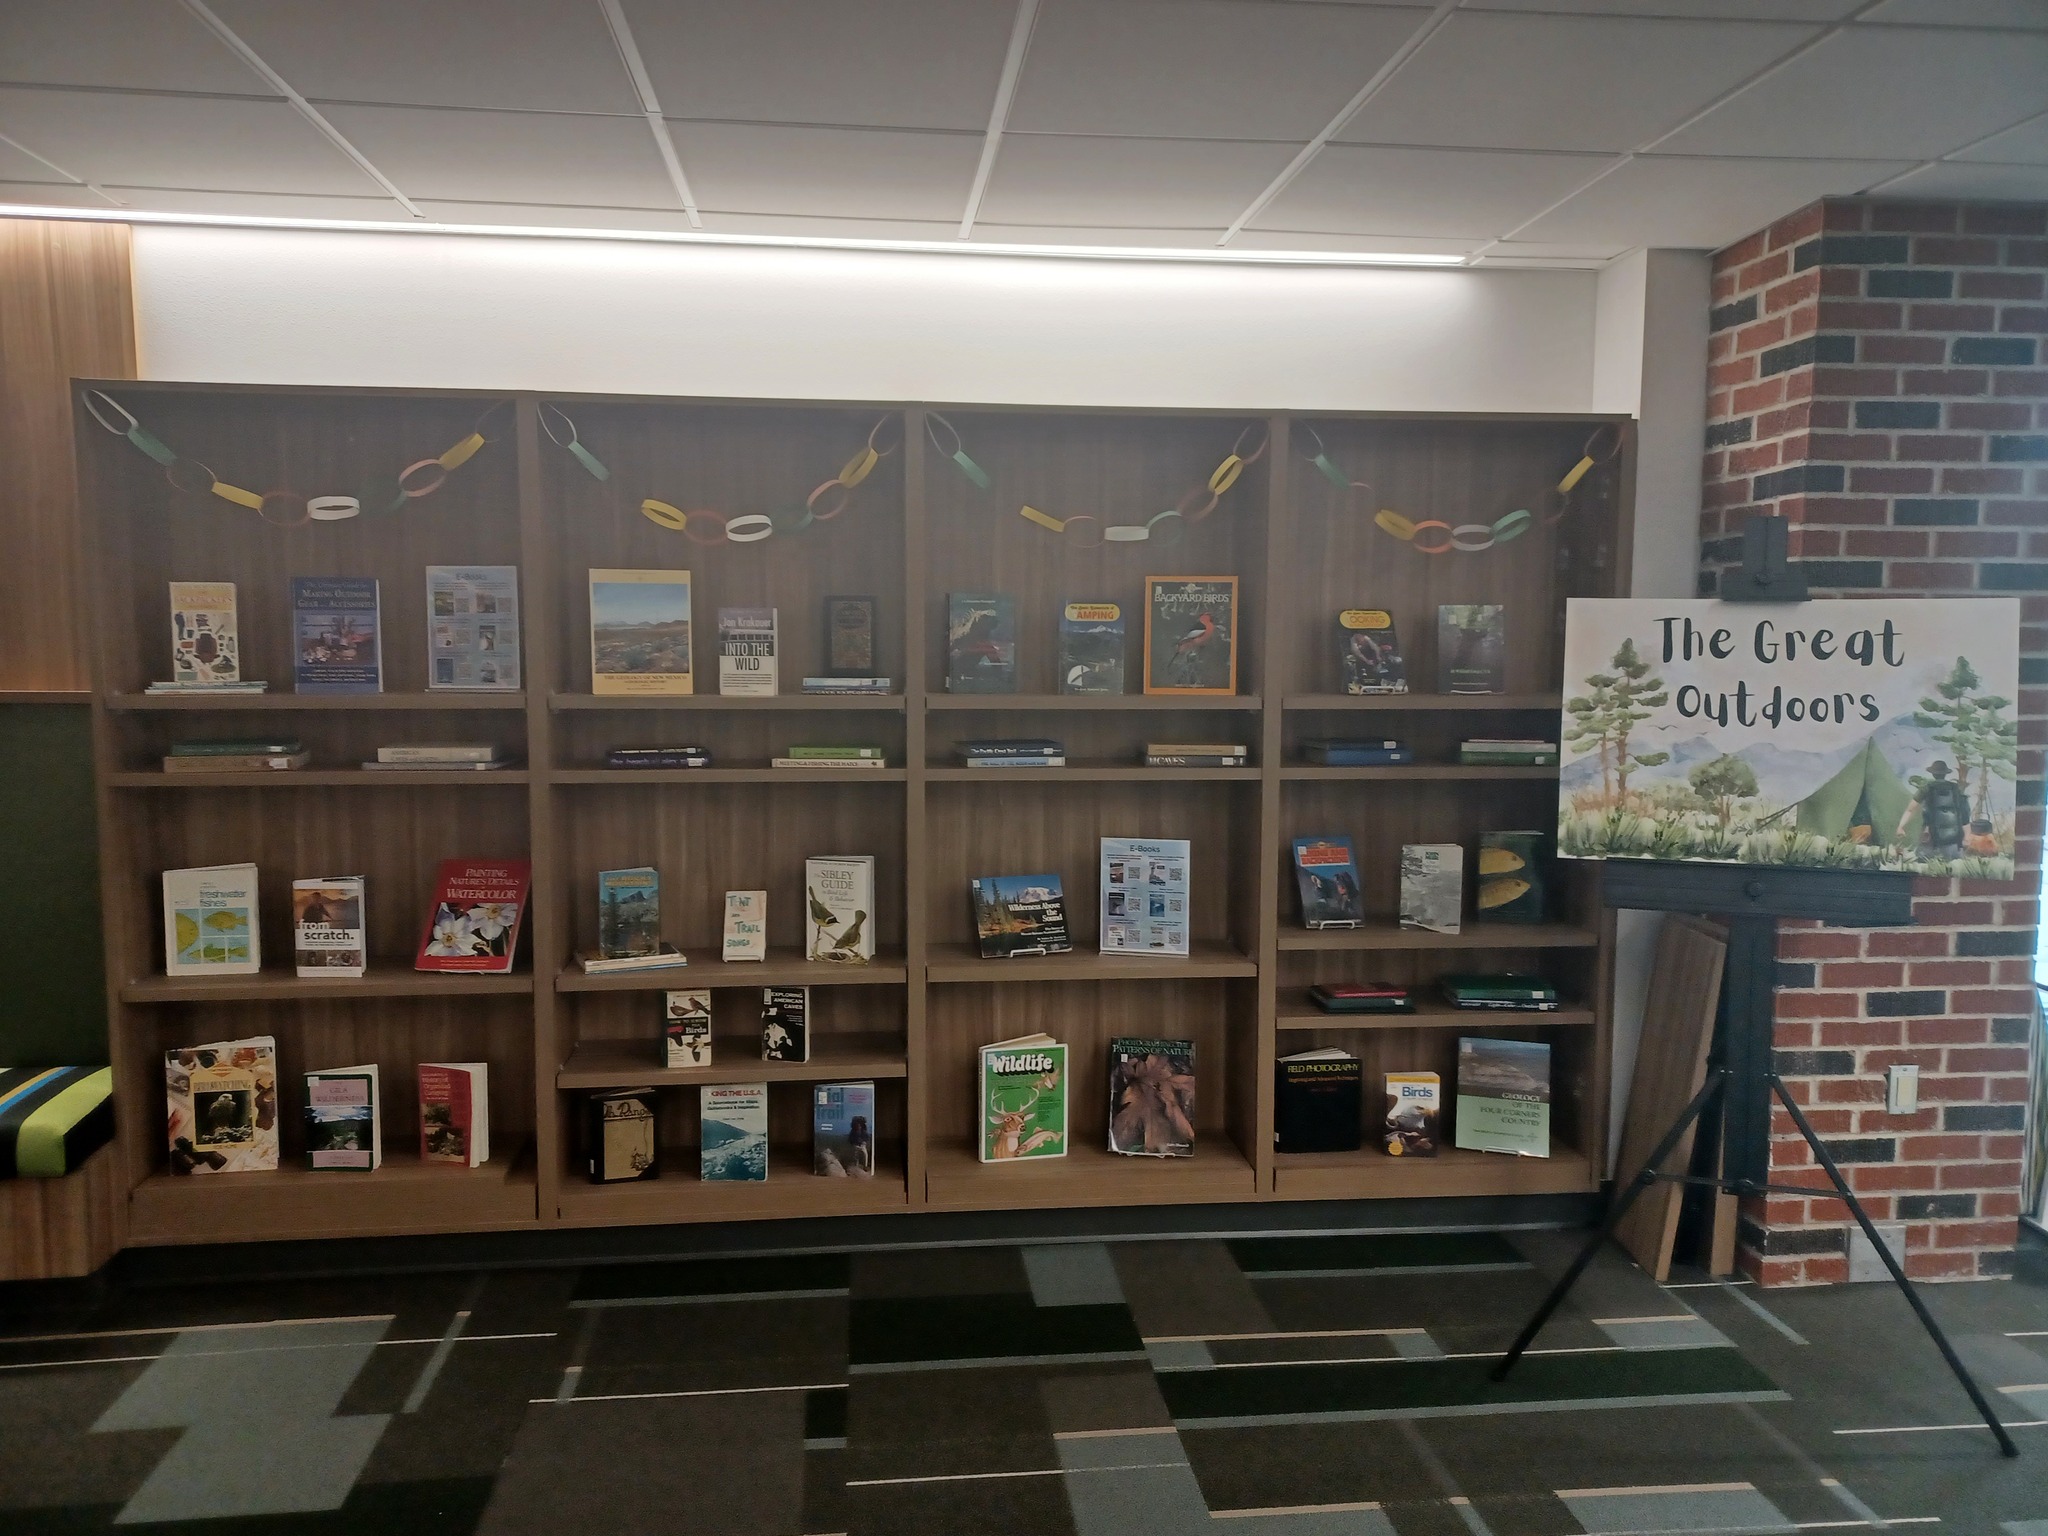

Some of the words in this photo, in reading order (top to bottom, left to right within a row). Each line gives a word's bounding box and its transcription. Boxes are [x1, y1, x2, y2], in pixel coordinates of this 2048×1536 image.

[1154, 594, 1202, 602] BACKYARD
[1204, 594, 1230, 603] BIRDS
[1076, 611, 1115, 620] AMPING
[1350, 615, 1386, 624] OOKING
[1653, 617, 1736, 664] The
[1753, 618, 1906, 667] Great
[725, 642, 749, 656] INTO
[751, 642, 770, 656] THE
[734, 657, 760, 671] WILD
[1676, 679, 1880, 729] Outdoors
[1130, 845, 1160, 853] E-Books
[465, 868, 508, 877] PAINTING
[821, 869, 854, 880] SIBLEY
[821, 880, 854, 890] GUIDE
[200, 890, 247, 899] freshwater
[447, 889, 517, 899] WATERCOLOR
[1008, 903, 1042, 912] Wilderness
[1042, 902, 1061, 910] Above
[1042, 914, 1063, 922] Sound
[300, 919, 330, 930] from
[304, 929, 354, 940] scratch.
[686, 1026, 707, 1034] Birds
[1113, 1045, 1150, 1053] PATTERNS
[1162, 1047, 1194, 1056] NATURE
[993, 1053, 1054, 1074] Wildlife
[1287, 1065, 1305, 1073] FIELD
[1306, 1063, 1359, 1072] PHOTOGRAPHY
[1402, 1086, 1433, 1097] Birds
[1501, 1092, 1540, 1102] GEOLOGY
[1480, 1106, 1502, 1114] FOUR
[1503, 1109, 1541, 1118] CORNERS
[1501, 1117, 1541, 1126] COUNTRY
